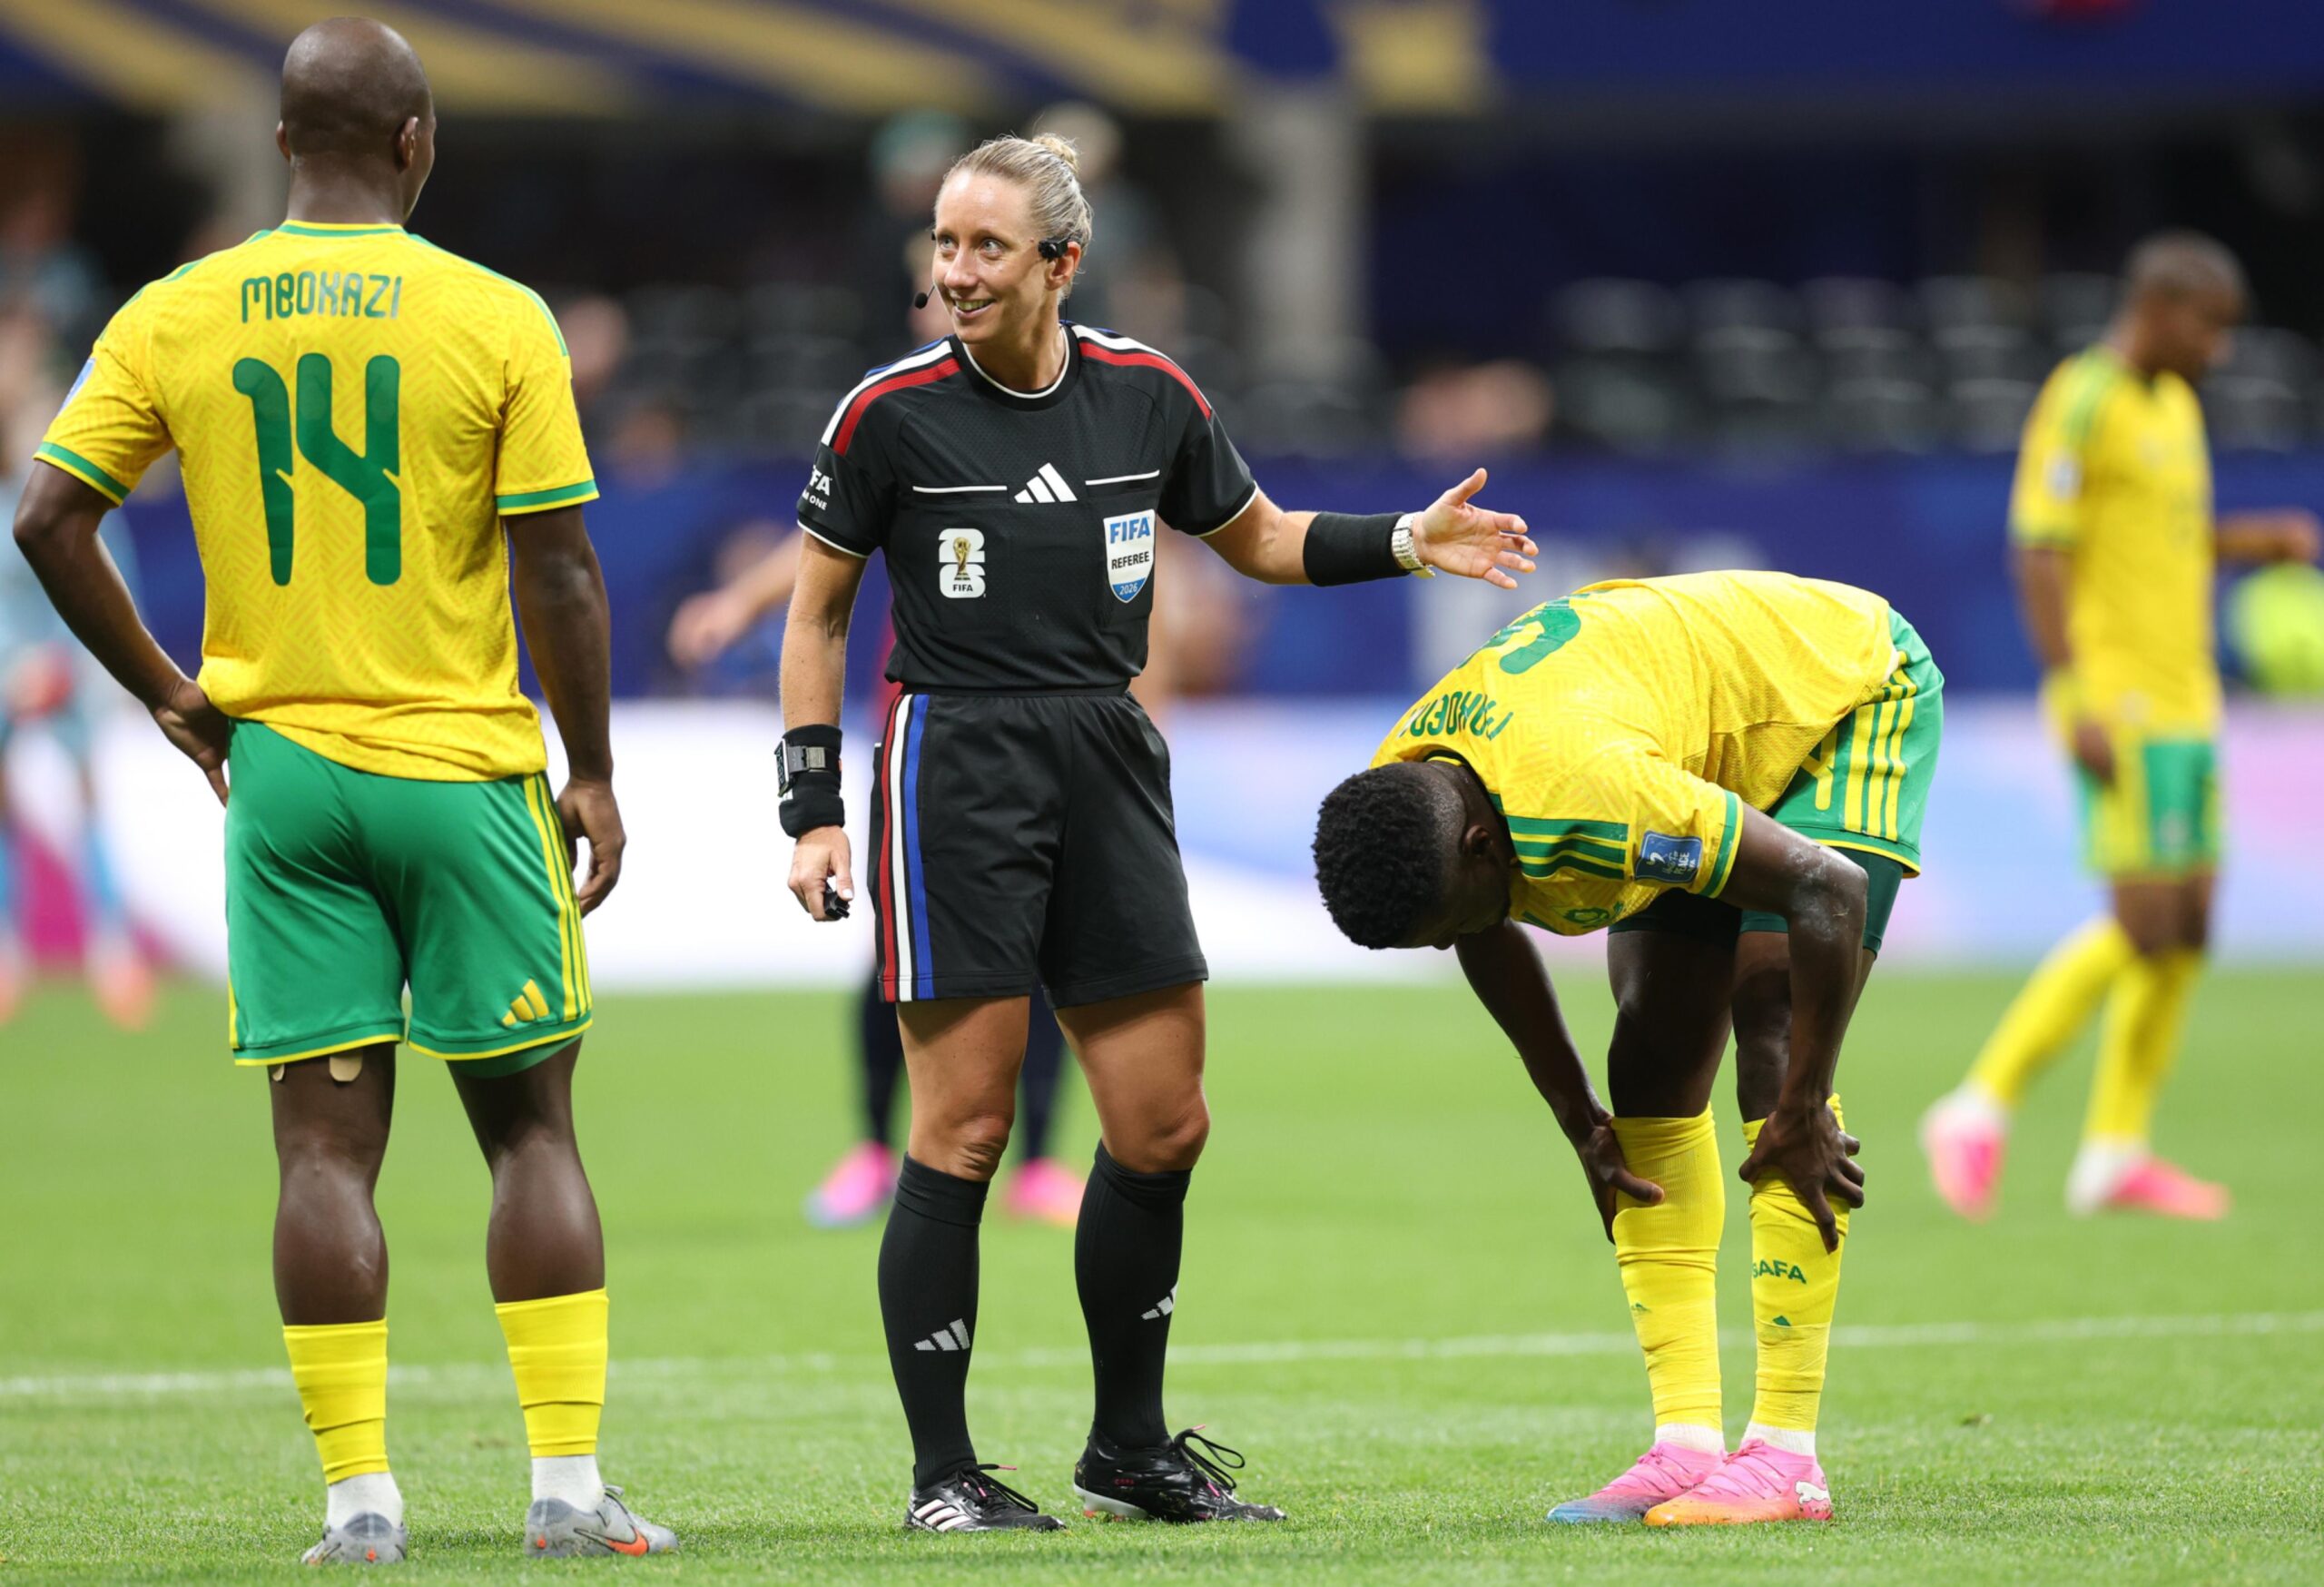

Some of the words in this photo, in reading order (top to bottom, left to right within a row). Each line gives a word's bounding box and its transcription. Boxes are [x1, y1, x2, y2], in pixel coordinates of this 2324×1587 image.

[241, 271, 402, 323] MBOKAZI
[232, 352, 401, 586] 14
[809, 464, 831, 497] FA
[809, 495, 828, 511] ONE
[1109, 516, 1151, 544] FIFA
[1111, 550, 1150, 570] REFEREE
[952, 584, 973, 592] FIFA
[1118, 582, 1139, 596] 2026
